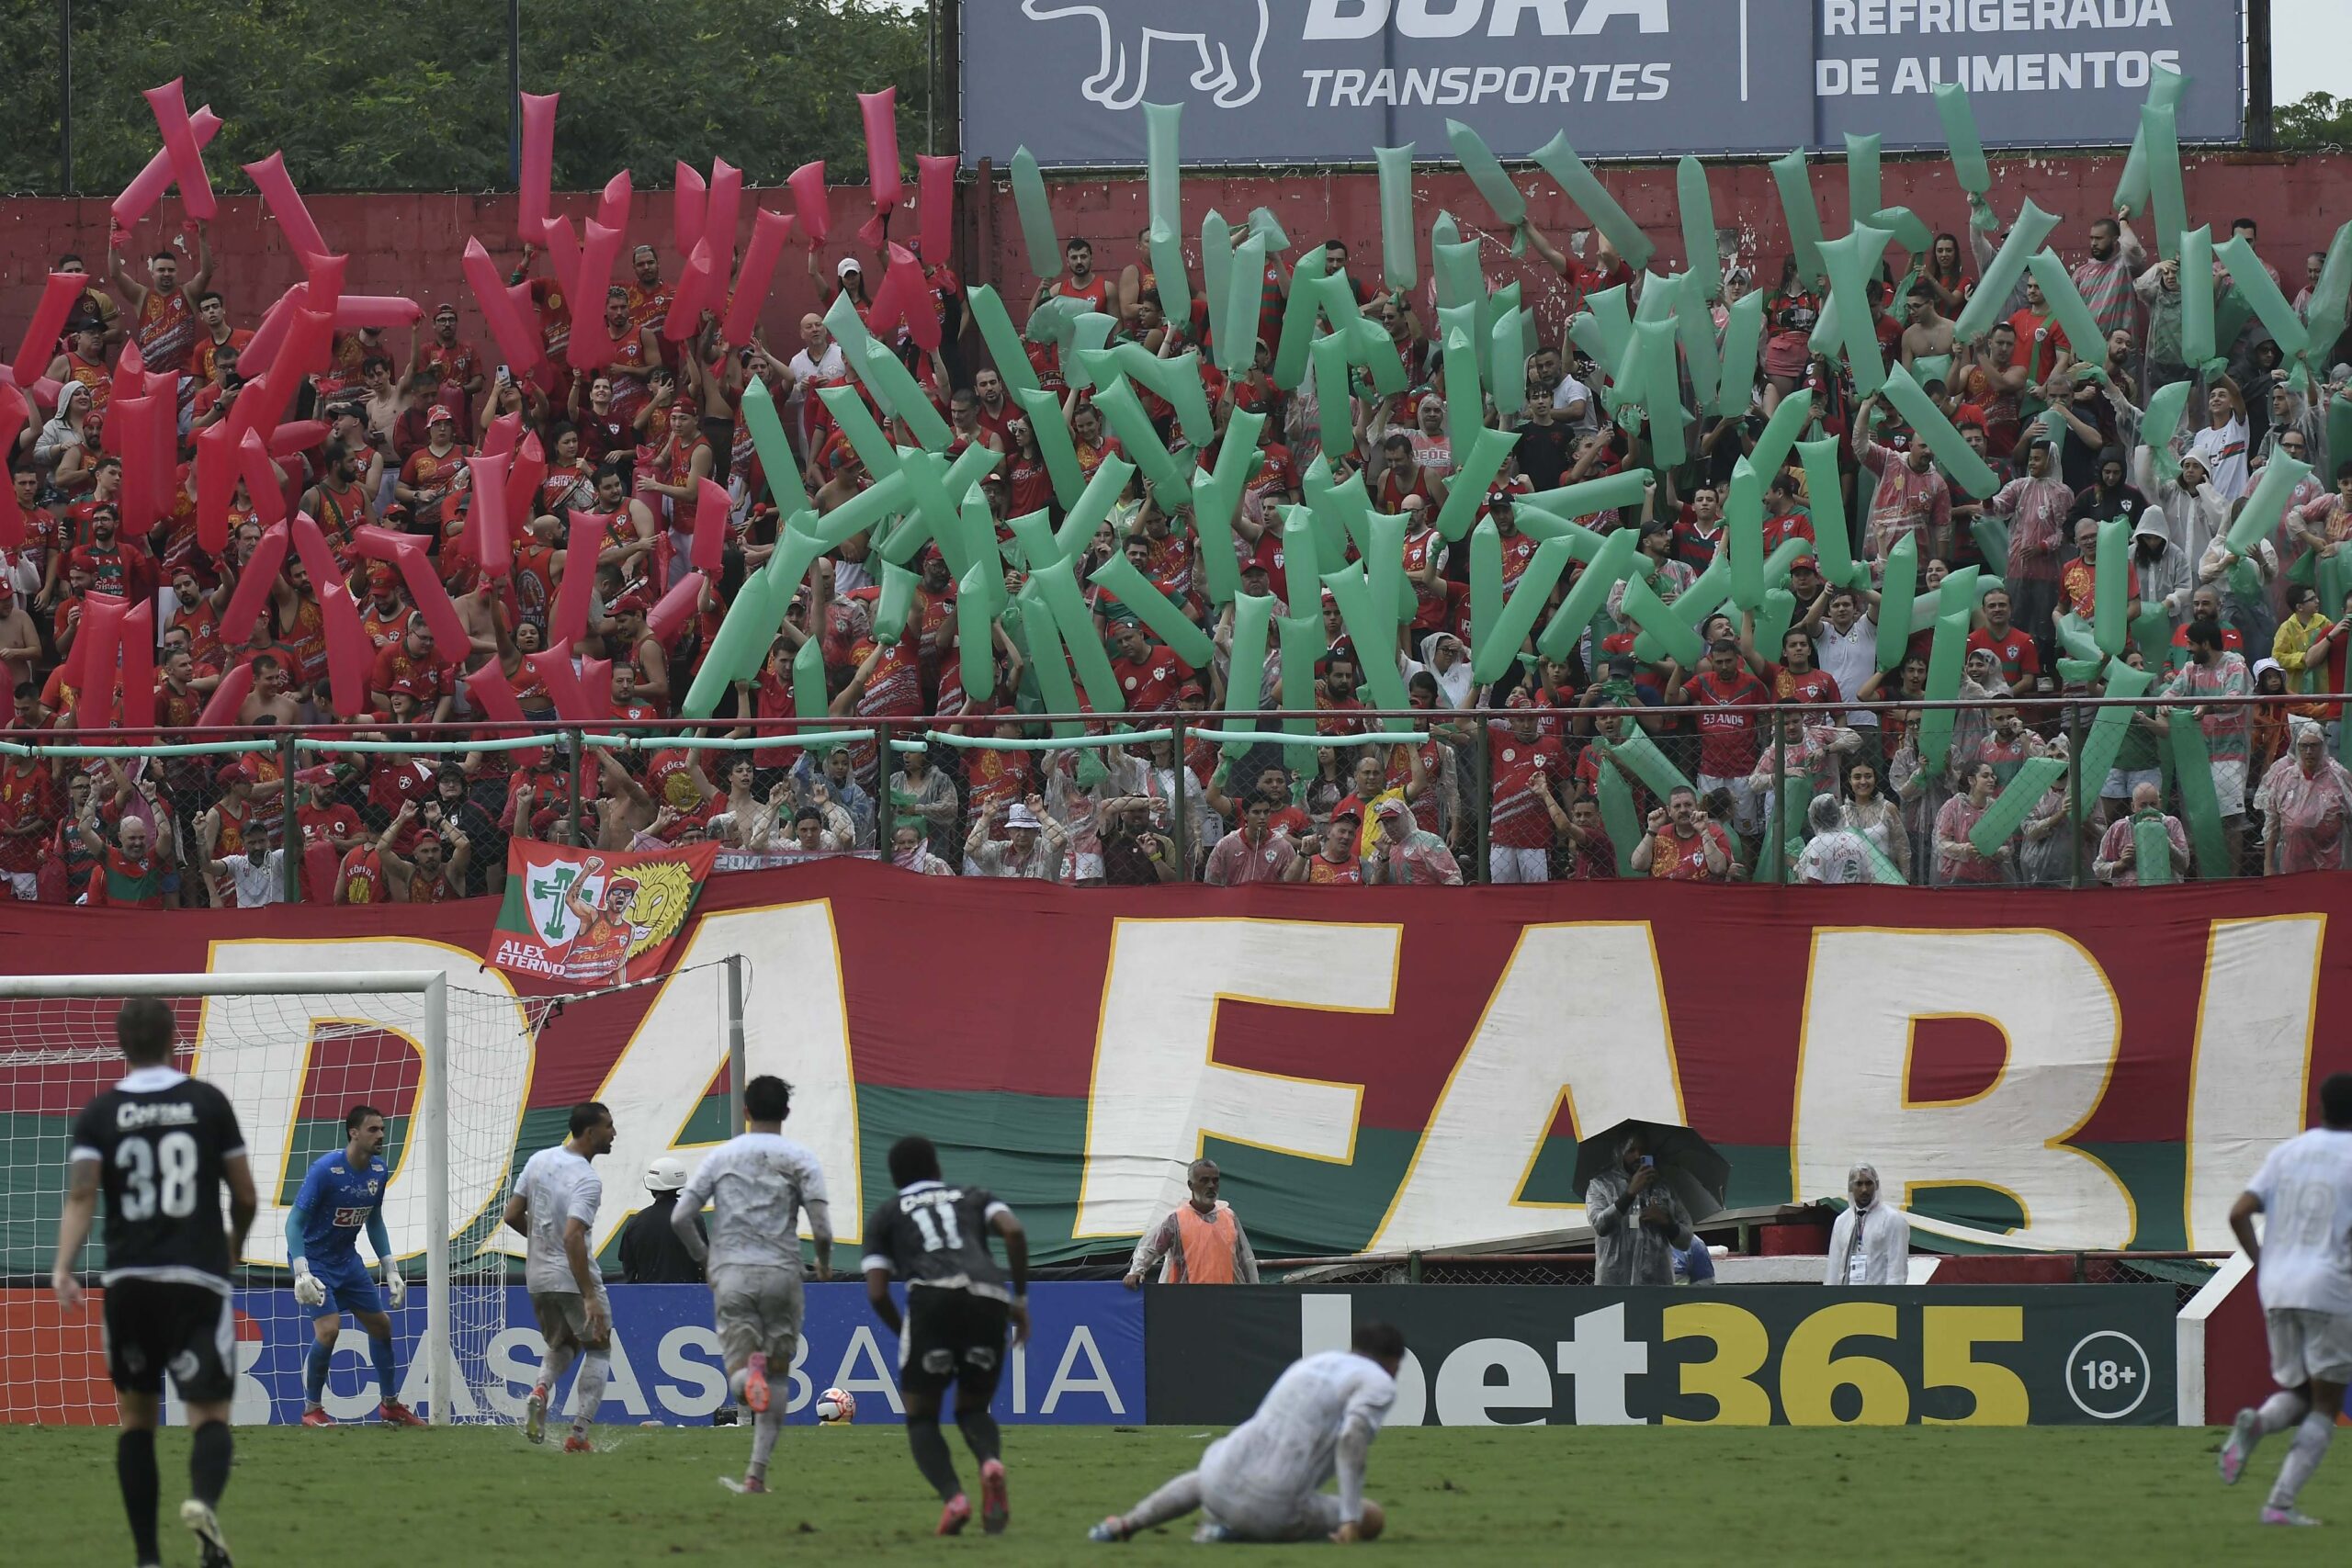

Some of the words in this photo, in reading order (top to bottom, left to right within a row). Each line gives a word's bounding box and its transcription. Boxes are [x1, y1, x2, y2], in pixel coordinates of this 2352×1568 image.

[1824, 0, 2173, 35] REFRIGERADA
[1302, 62, 1671, 107] TRANSPORTES
[1816, 59, 1880, 96] DE
[1891, 50, 2182, 95] ALIMENTOS
[1702, 714, 1715, 726] 53
[1716, 713, 1744, 727] ANOS
[495, 952, 567, 976] ETERNO
[498, 939, 547, 958] ALEX
[179, 897, 863, 1267] DA
[115, 1131, 198, 1223] 38
[911, 1202, 964, 1252] 11
[2082, 1360, 2137, 1391] 18+
